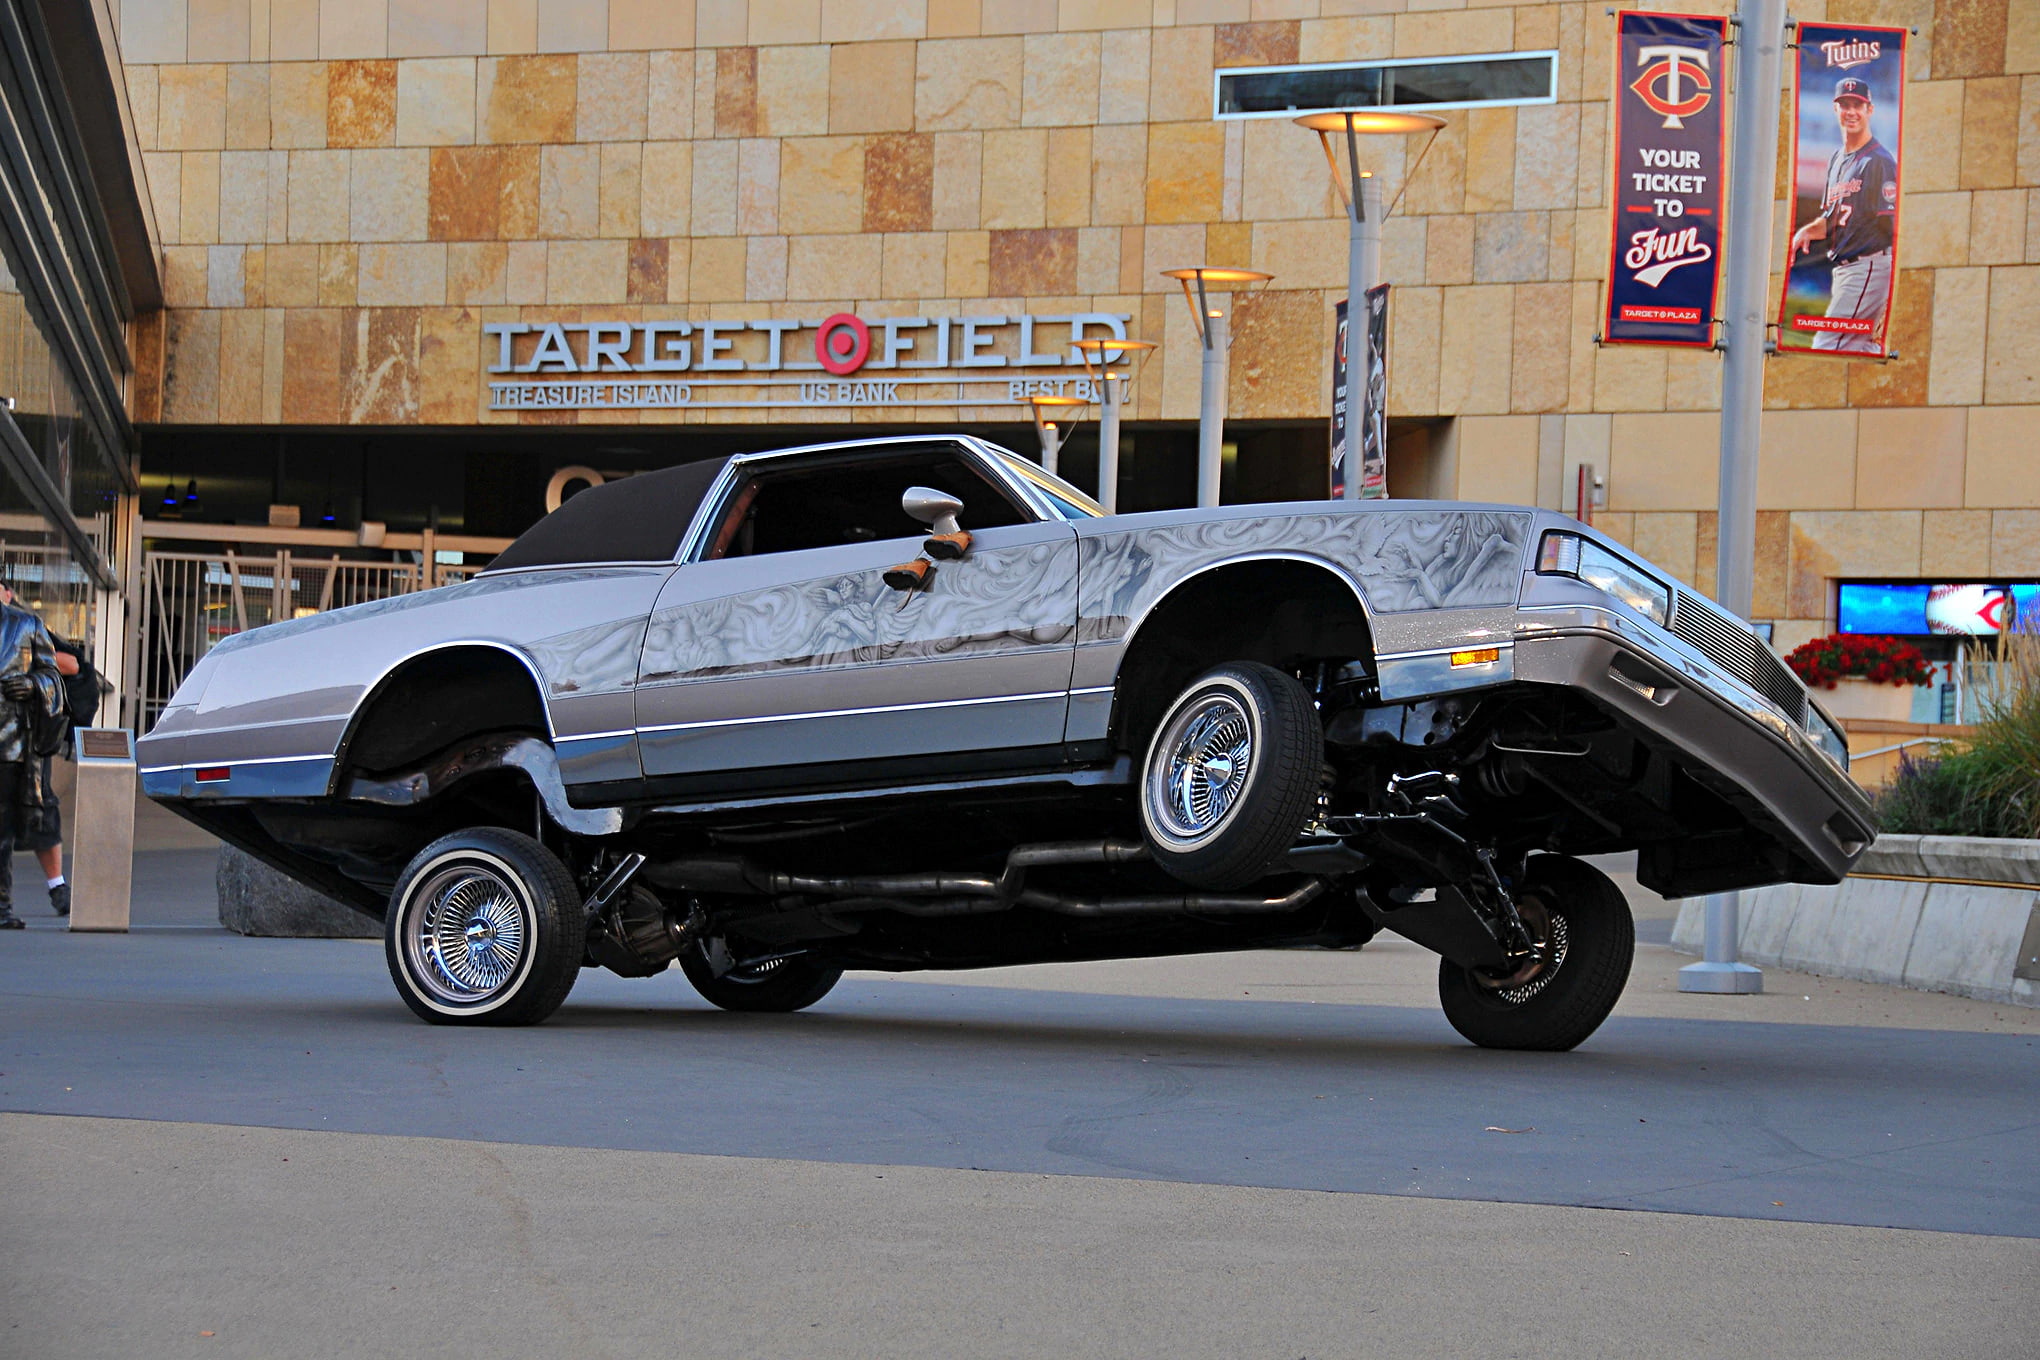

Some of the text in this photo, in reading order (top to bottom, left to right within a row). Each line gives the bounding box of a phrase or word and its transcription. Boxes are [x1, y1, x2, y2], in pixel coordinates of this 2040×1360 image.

[1821, 38, 1880, 69] Twins
[1639, 148, 1701, 169] YOUR
[1632, 172, 1706, 193] TICKET
[1654, 199, 1684, 218] TO
[1839, 203, 1853, 227] 7
[1626, 227, 1711, 276] Fun
[1624, 309, 1698, 320] TARGET PLAZA
[1796, 318, 1870, 331] TARGET PLAZA
[484, 312, 1129, 373] TARGET FIELD
[493, 384, 692, 405] TREASURE ISLAND
[801, 383, 900, 403] US BANK
[1009, 380, 1069, 400] BEST
